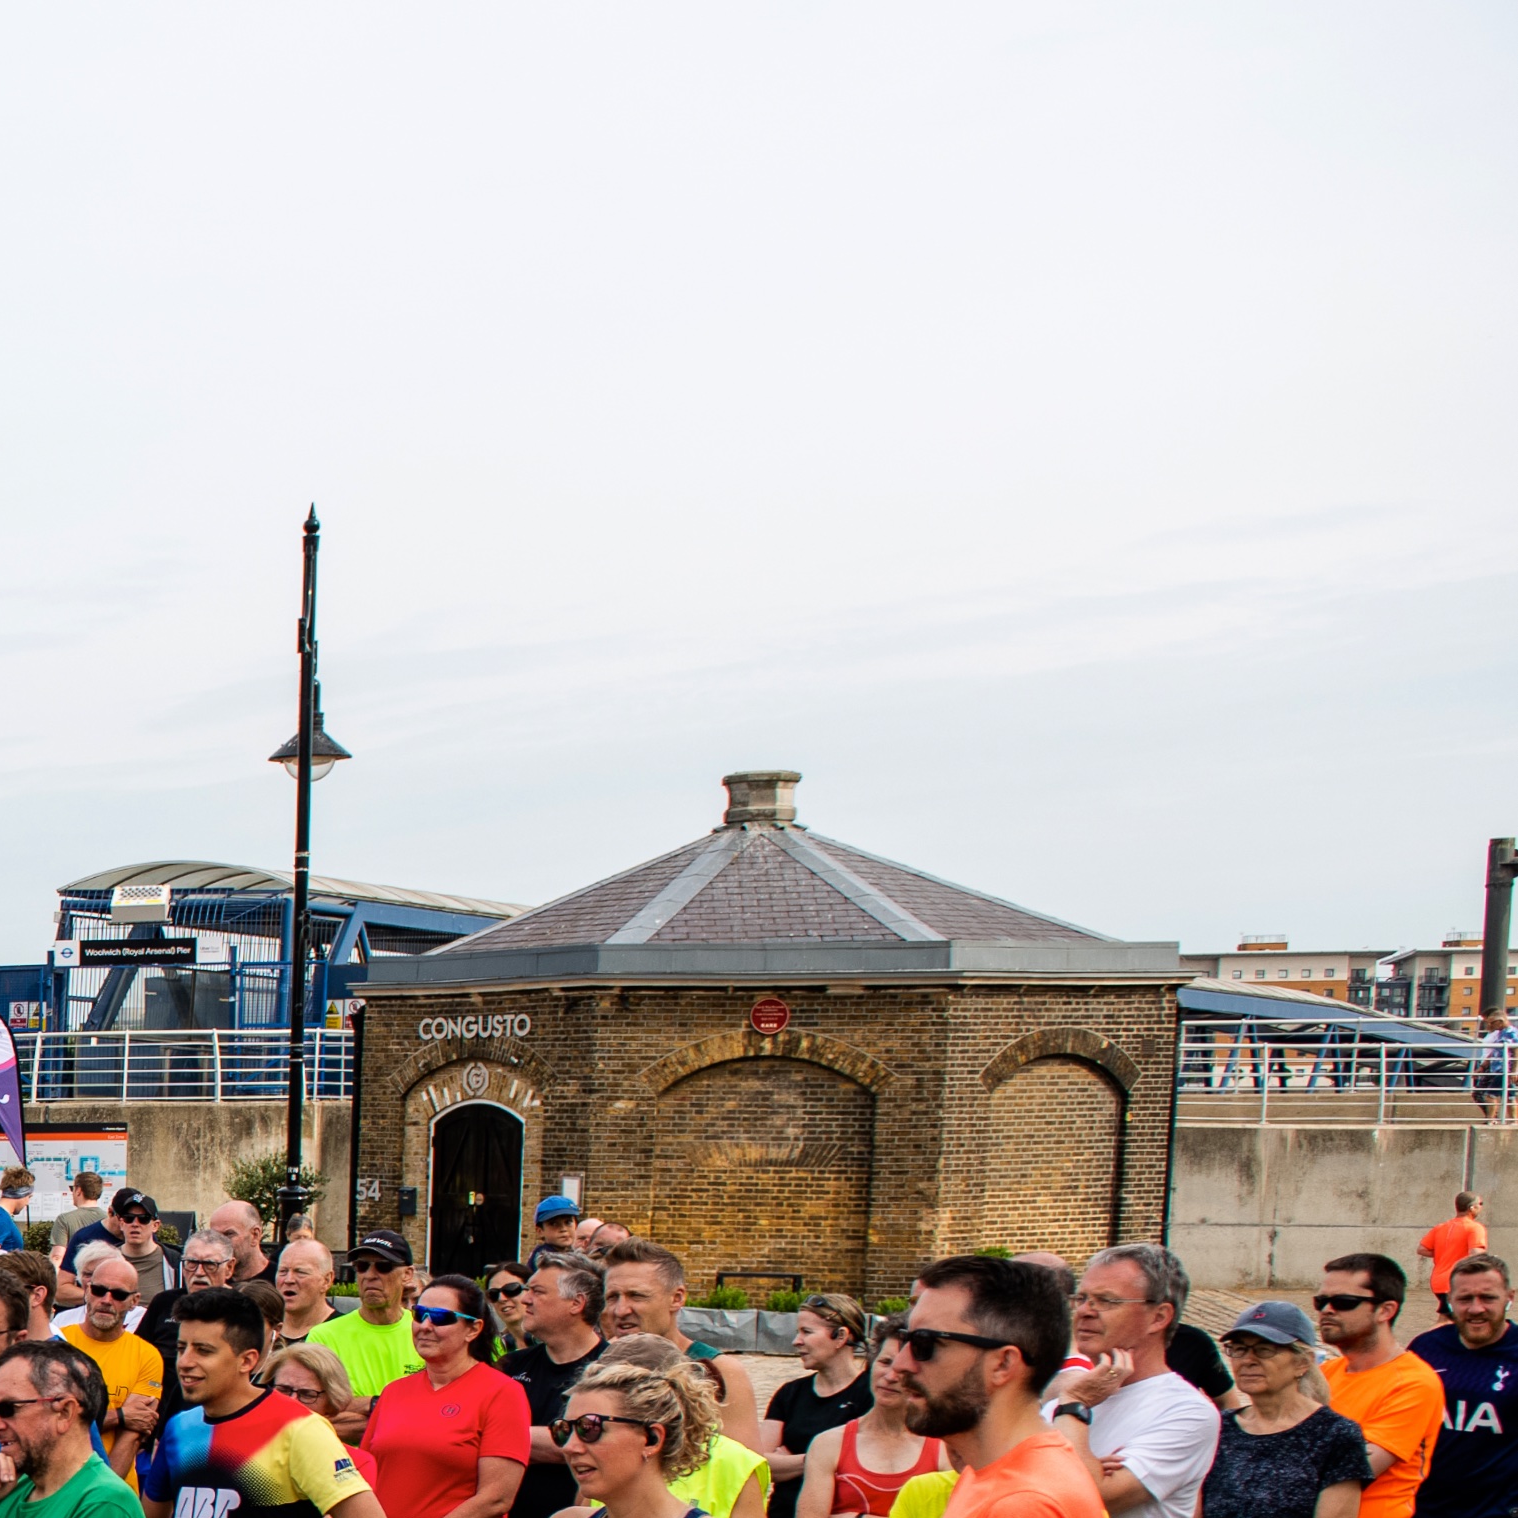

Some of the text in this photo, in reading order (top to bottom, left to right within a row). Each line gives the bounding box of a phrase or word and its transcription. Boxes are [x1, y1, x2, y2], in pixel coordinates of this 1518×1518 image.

[85, 946, 191, 957] Woolwich (Royal Arsenal) Pier
[419, 1013, 531, 1040] CONGUSTO
[357, 1179, 381, 1201] 54
